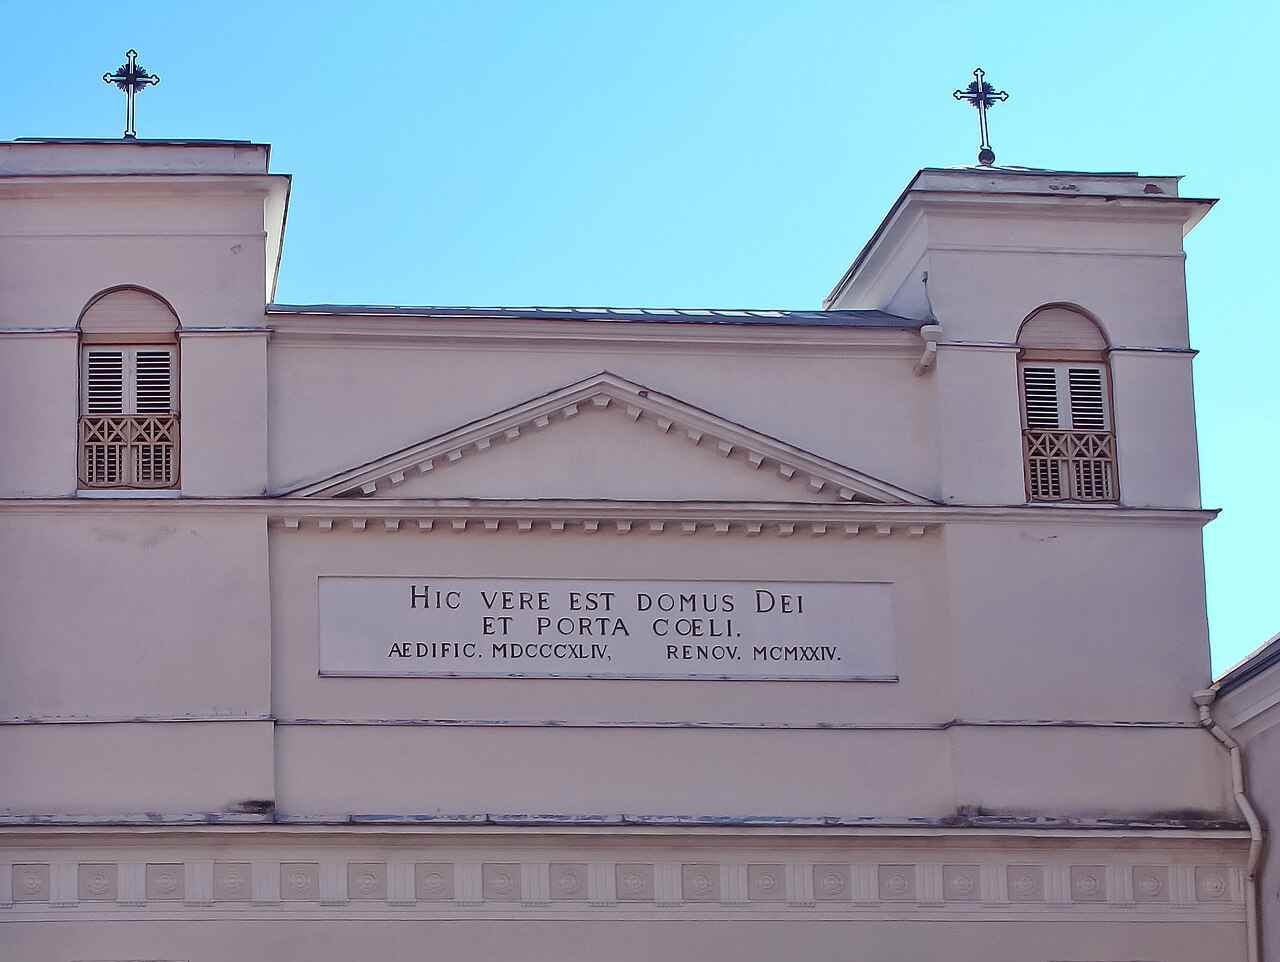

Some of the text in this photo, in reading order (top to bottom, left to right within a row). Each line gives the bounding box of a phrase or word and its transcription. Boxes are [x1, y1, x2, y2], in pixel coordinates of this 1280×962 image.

[481, 591, 551, 610] VERE
[570, 592, 615, 611] EST
[637, 593, 735, 612] DOMUS
[483, 616, 513, 635] ET
[537, 617, 630, 636] PORTA
[667, 645, 741, 660] RENOV.
[753, 646, 841, 661] MCMXXIV.
